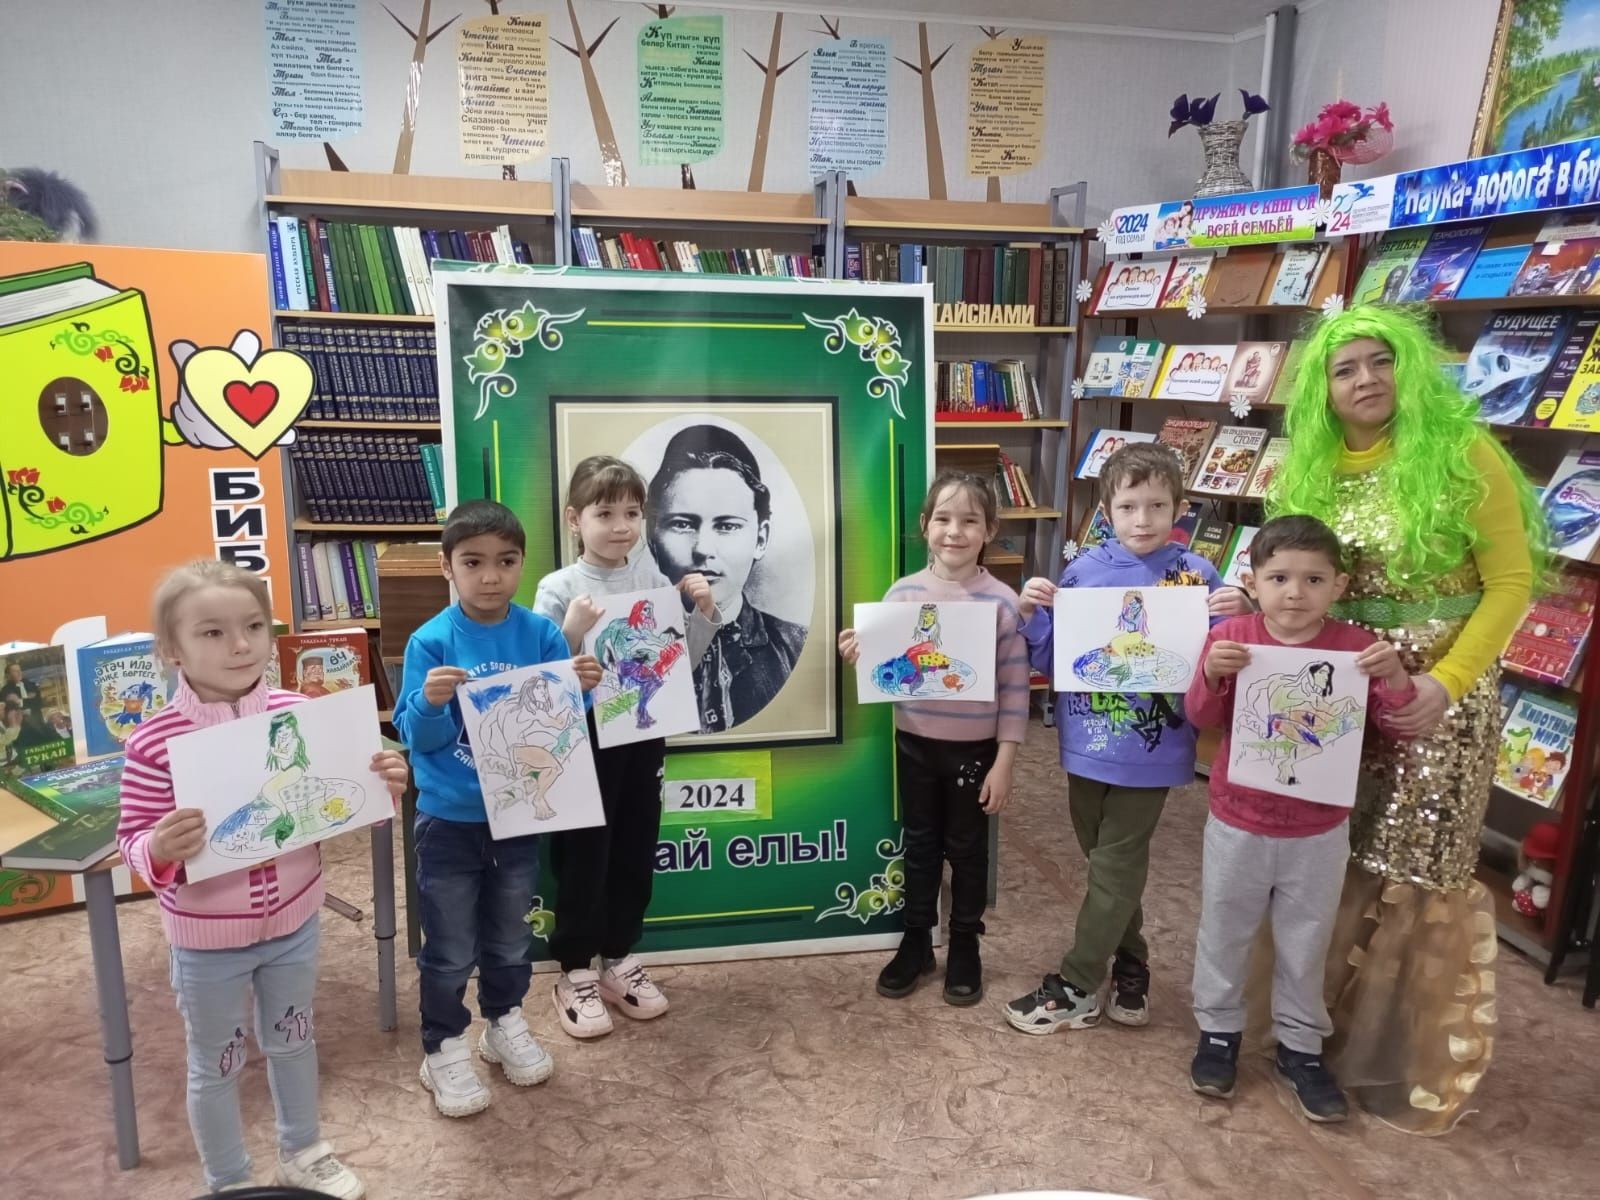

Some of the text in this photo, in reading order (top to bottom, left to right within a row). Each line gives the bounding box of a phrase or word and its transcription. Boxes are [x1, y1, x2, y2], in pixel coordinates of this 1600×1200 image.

[507, 16, 542, 28] Книга
[461, 29, 500, 41] Чтение
[486, 41, 515, 52] Книга
[666, 41, 691, 49] Китап
[458, 52, 494, 63] Книга
[506, 65, 548, 77] Счастье
[461, 114, 548, 127] Сказанное учит
[501, 134, 546, 148] Чтение
[1556, 161, 1571, 196] в
[1572, 148, 1600, 204] бу
[1193, 191, 1317, 223] ДРУЖИМ С КНИГОЙ
[1119, 213, 1149, 234] 2024
[1207, 215, 1295, 239] ВСЕЙ СЕМЬЁЙ
[1330, 211, 1351, 232] 24
[1493, 315, 1562, 331] БУДУЩЕЕ
[1232, 435, 1261, 446] СТОЛЕ
[467, 660, 488, 678] NYC
[1533, 727, 1568, 751] МИРА
[26, 748, 67, 765] ТУКАЙ
[680, 784, 745, 809] 2024
[727, 820, 848, 868] елы!
